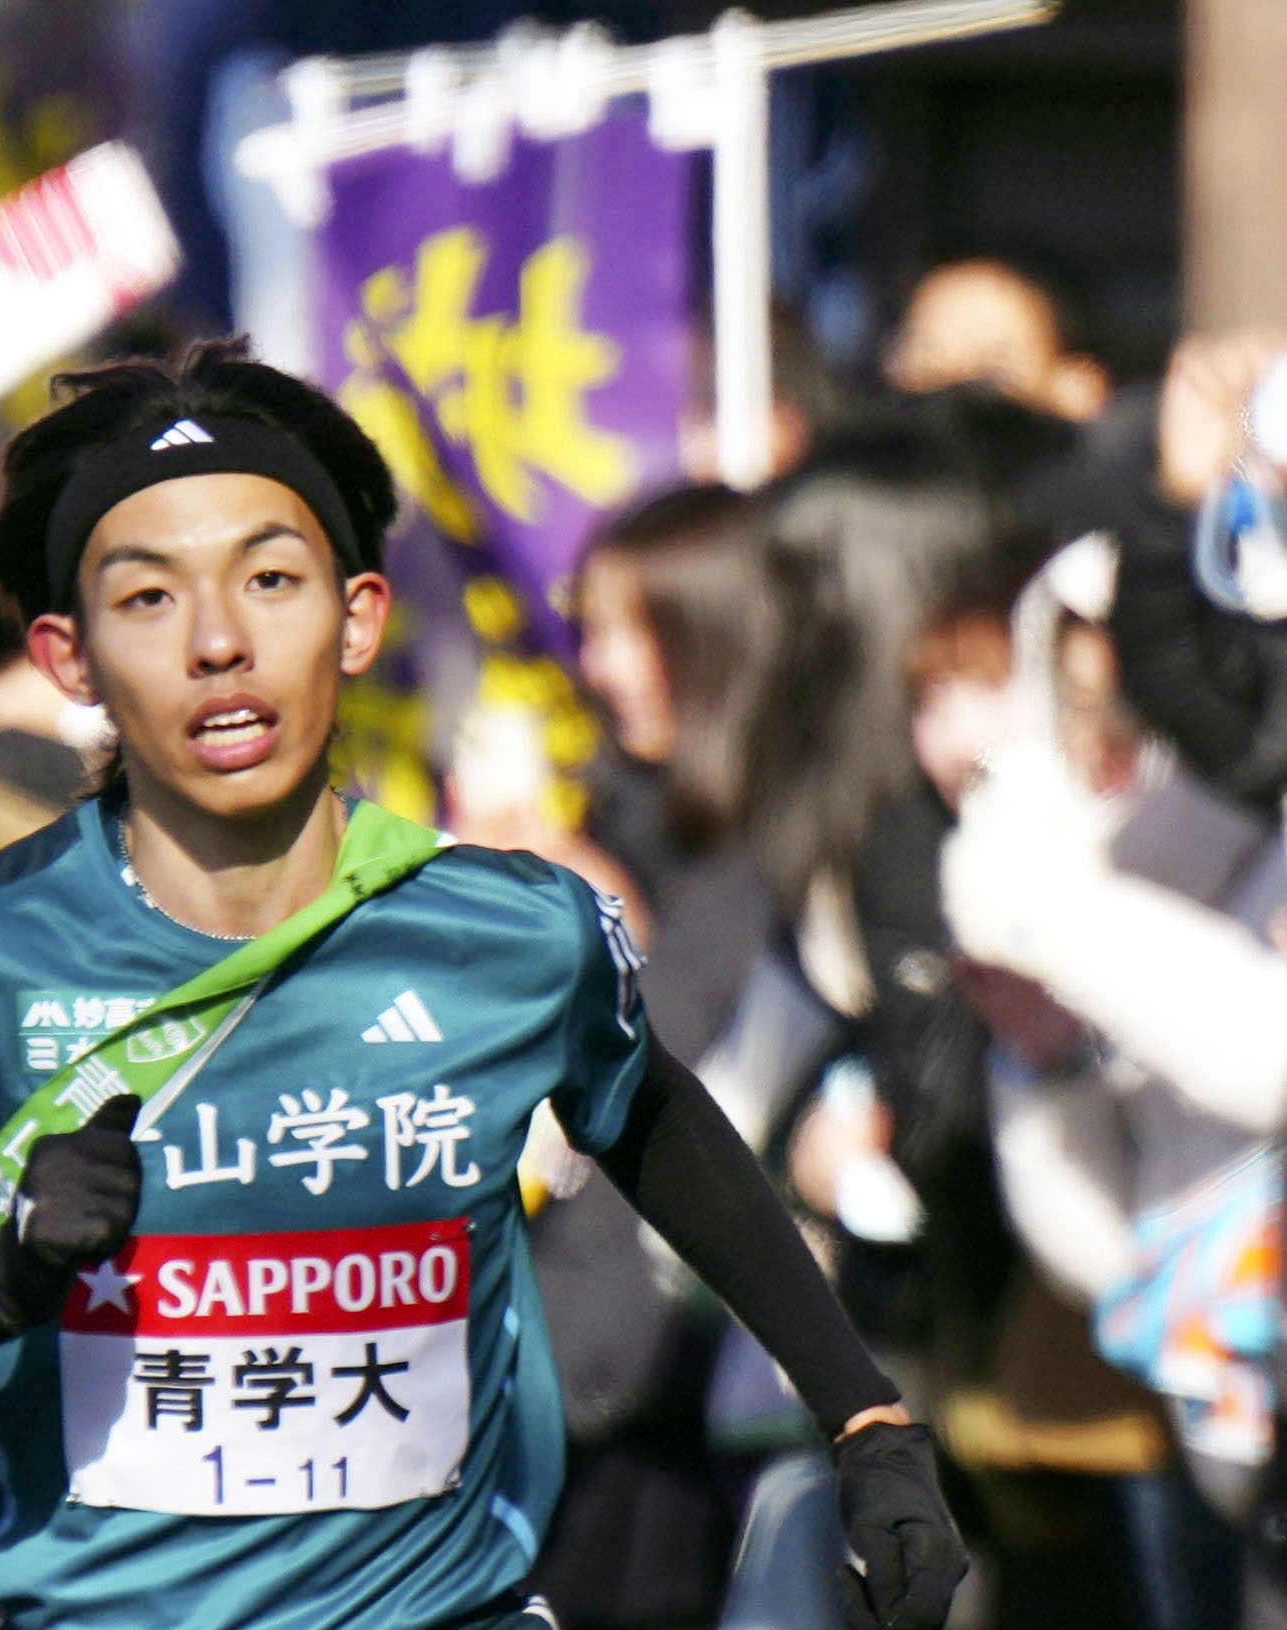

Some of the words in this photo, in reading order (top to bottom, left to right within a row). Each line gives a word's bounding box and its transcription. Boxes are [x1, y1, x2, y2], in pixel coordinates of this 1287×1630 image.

[130, 1084, 481, 1196] 山学院
[157, 1246, 458, 1319] SAPPORO
[134, 1342, 411, 1432] 青学大
[202, 1445, 348, 1505] 1-11
